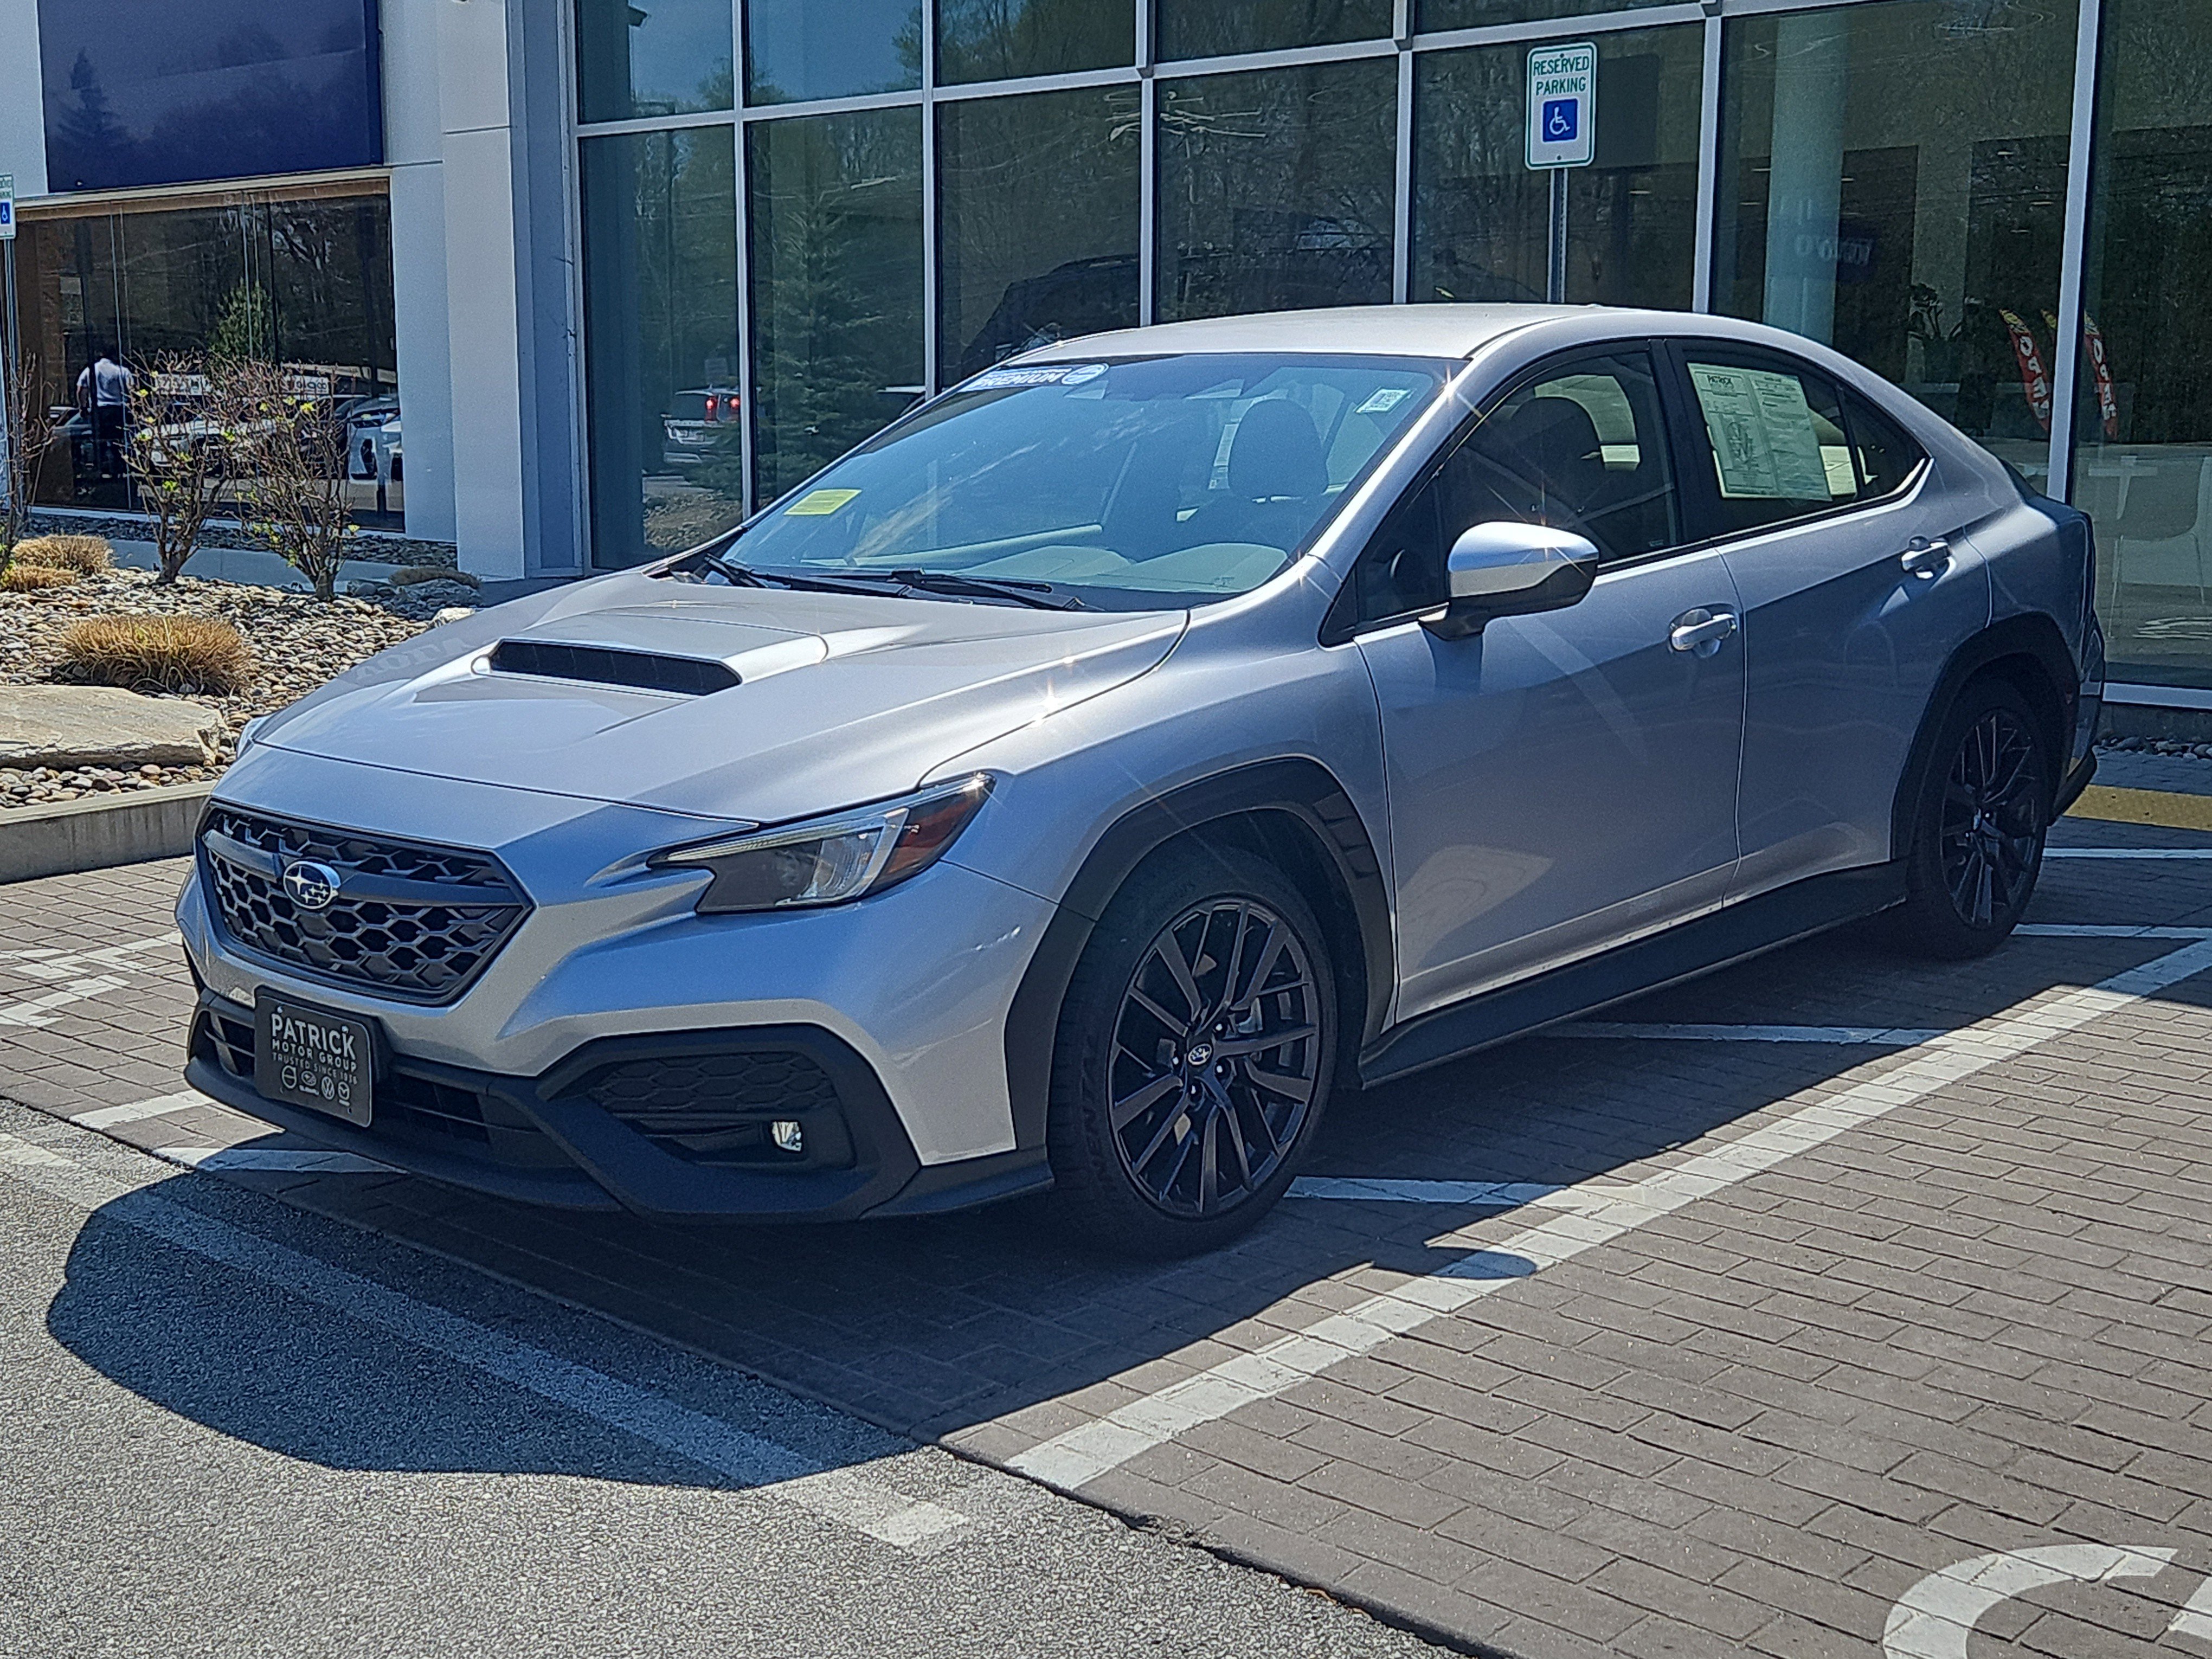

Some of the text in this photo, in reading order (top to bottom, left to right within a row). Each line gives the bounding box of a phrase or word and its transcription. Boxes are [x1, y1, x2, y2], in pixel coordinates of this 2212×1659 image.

[1533, 56, 1590, 76] RESERVED
[1535, 76, 1586, 96] PARKING
[974, 372, 1064, 386] PREMIUM
[271, 1013, 356, 1060] PATRICK
[272, 1038, 357, 1072] MOTOR GROUP
[272, 1052, 310, 1069] TRUSTED
[313, 1063, 337, 1078] SINCE
